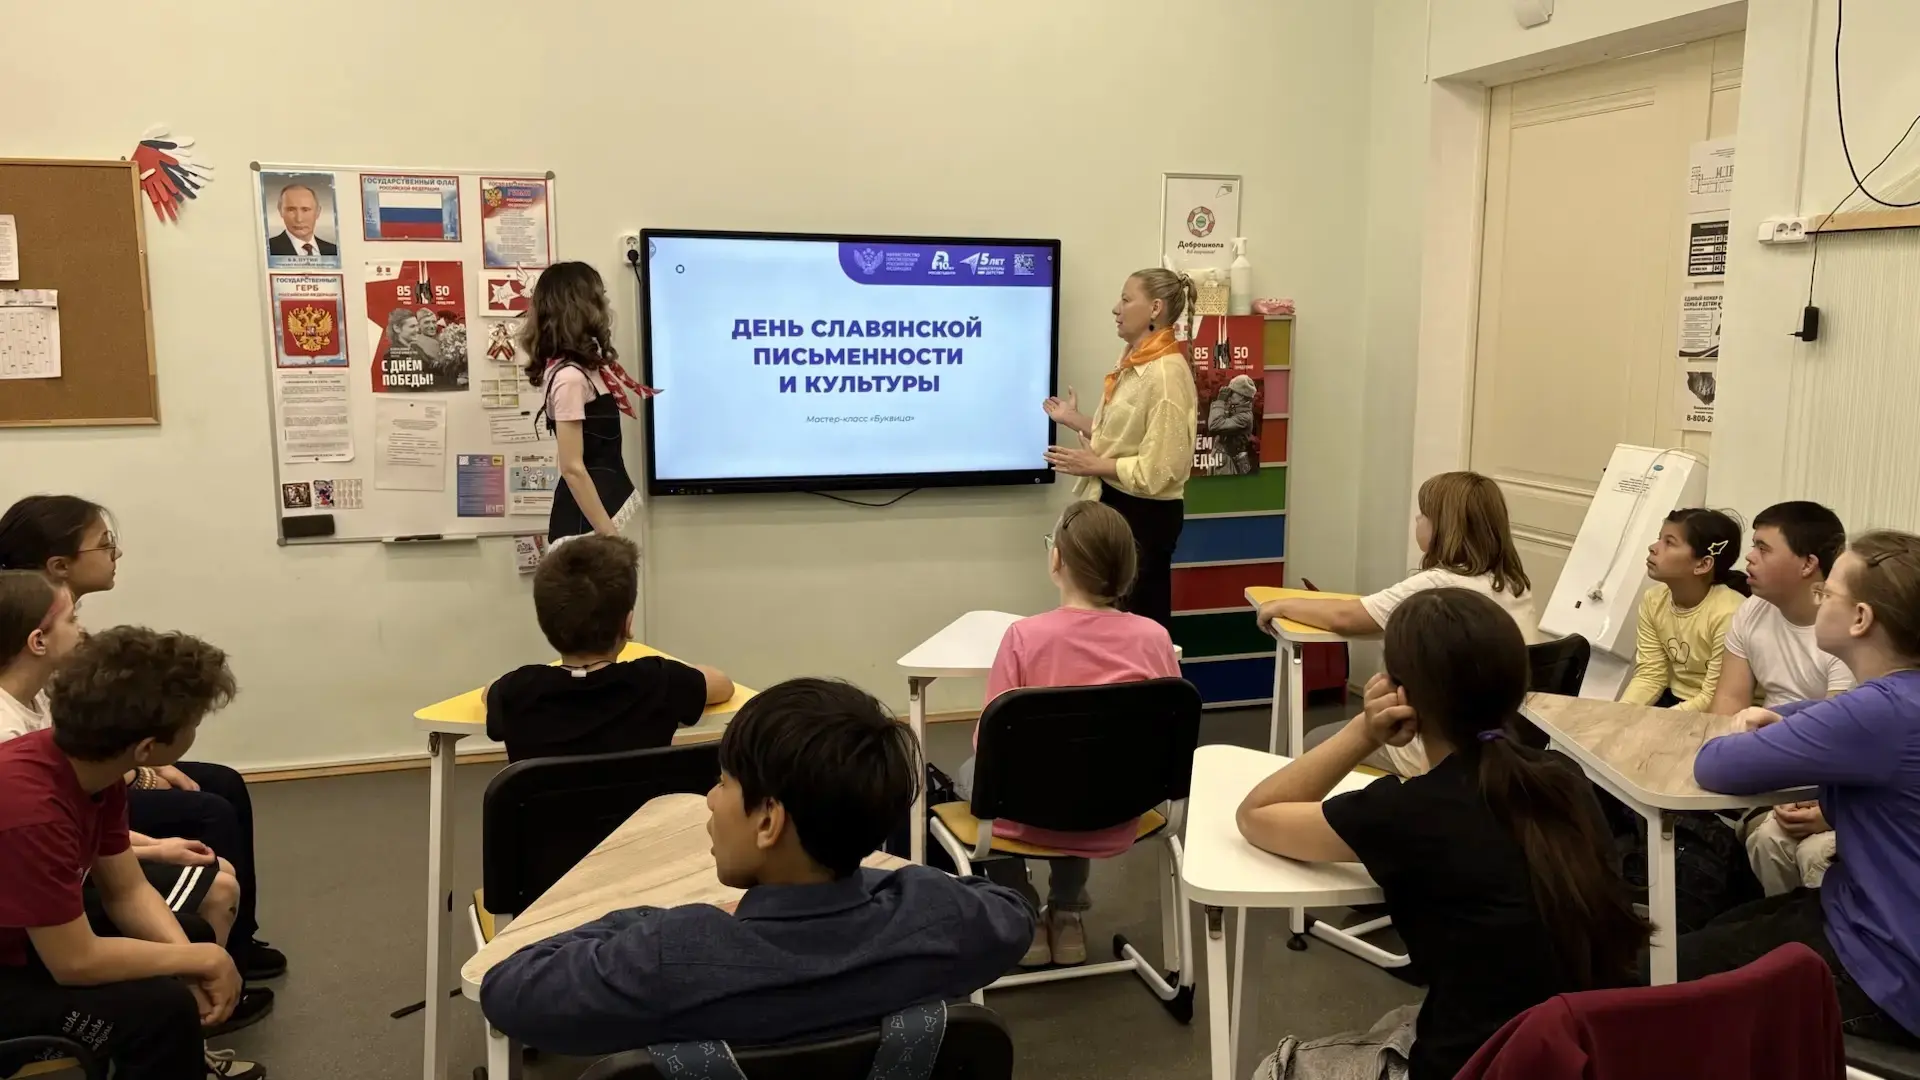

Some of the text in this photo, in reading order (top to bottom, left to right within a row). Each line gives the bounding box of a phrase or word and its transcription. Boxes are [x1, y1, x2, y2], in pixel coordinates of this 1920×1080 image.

[363, 177, 435, 186] ГОСУДАРСТВЕННЫЙ
[1177, 240, 1224, 249] Доброшкола
[979, 252, 1006, 266] 5 ЛЕТ
[295, 284, 320, 292] ГЕРБ
[396, 285, 411, 296] 85
[435, 285, 450, 296] 50
[731, 316, 983, 340] ДЕНЬ СЛАВЯНСКОЙ
[753, 347, 964, 366] ПИСЬМЕННОСТИ
[1194, 346, 1209, 360] 85
[1233, 346, 1249, 359] 50
[381, 357, 423, 374] С ДНЁМ
[382, 373, 434, 388] ПОБЕДЫ!
[779, 375, 941, 394] И КУЛЬТУРЫ
[806, 414, 915, 425] Мастер-класс «Буквица»
[1195, 433, 1213, 450] ЁМ
[1193, 452, 1223, 470] ЕДЫ!
